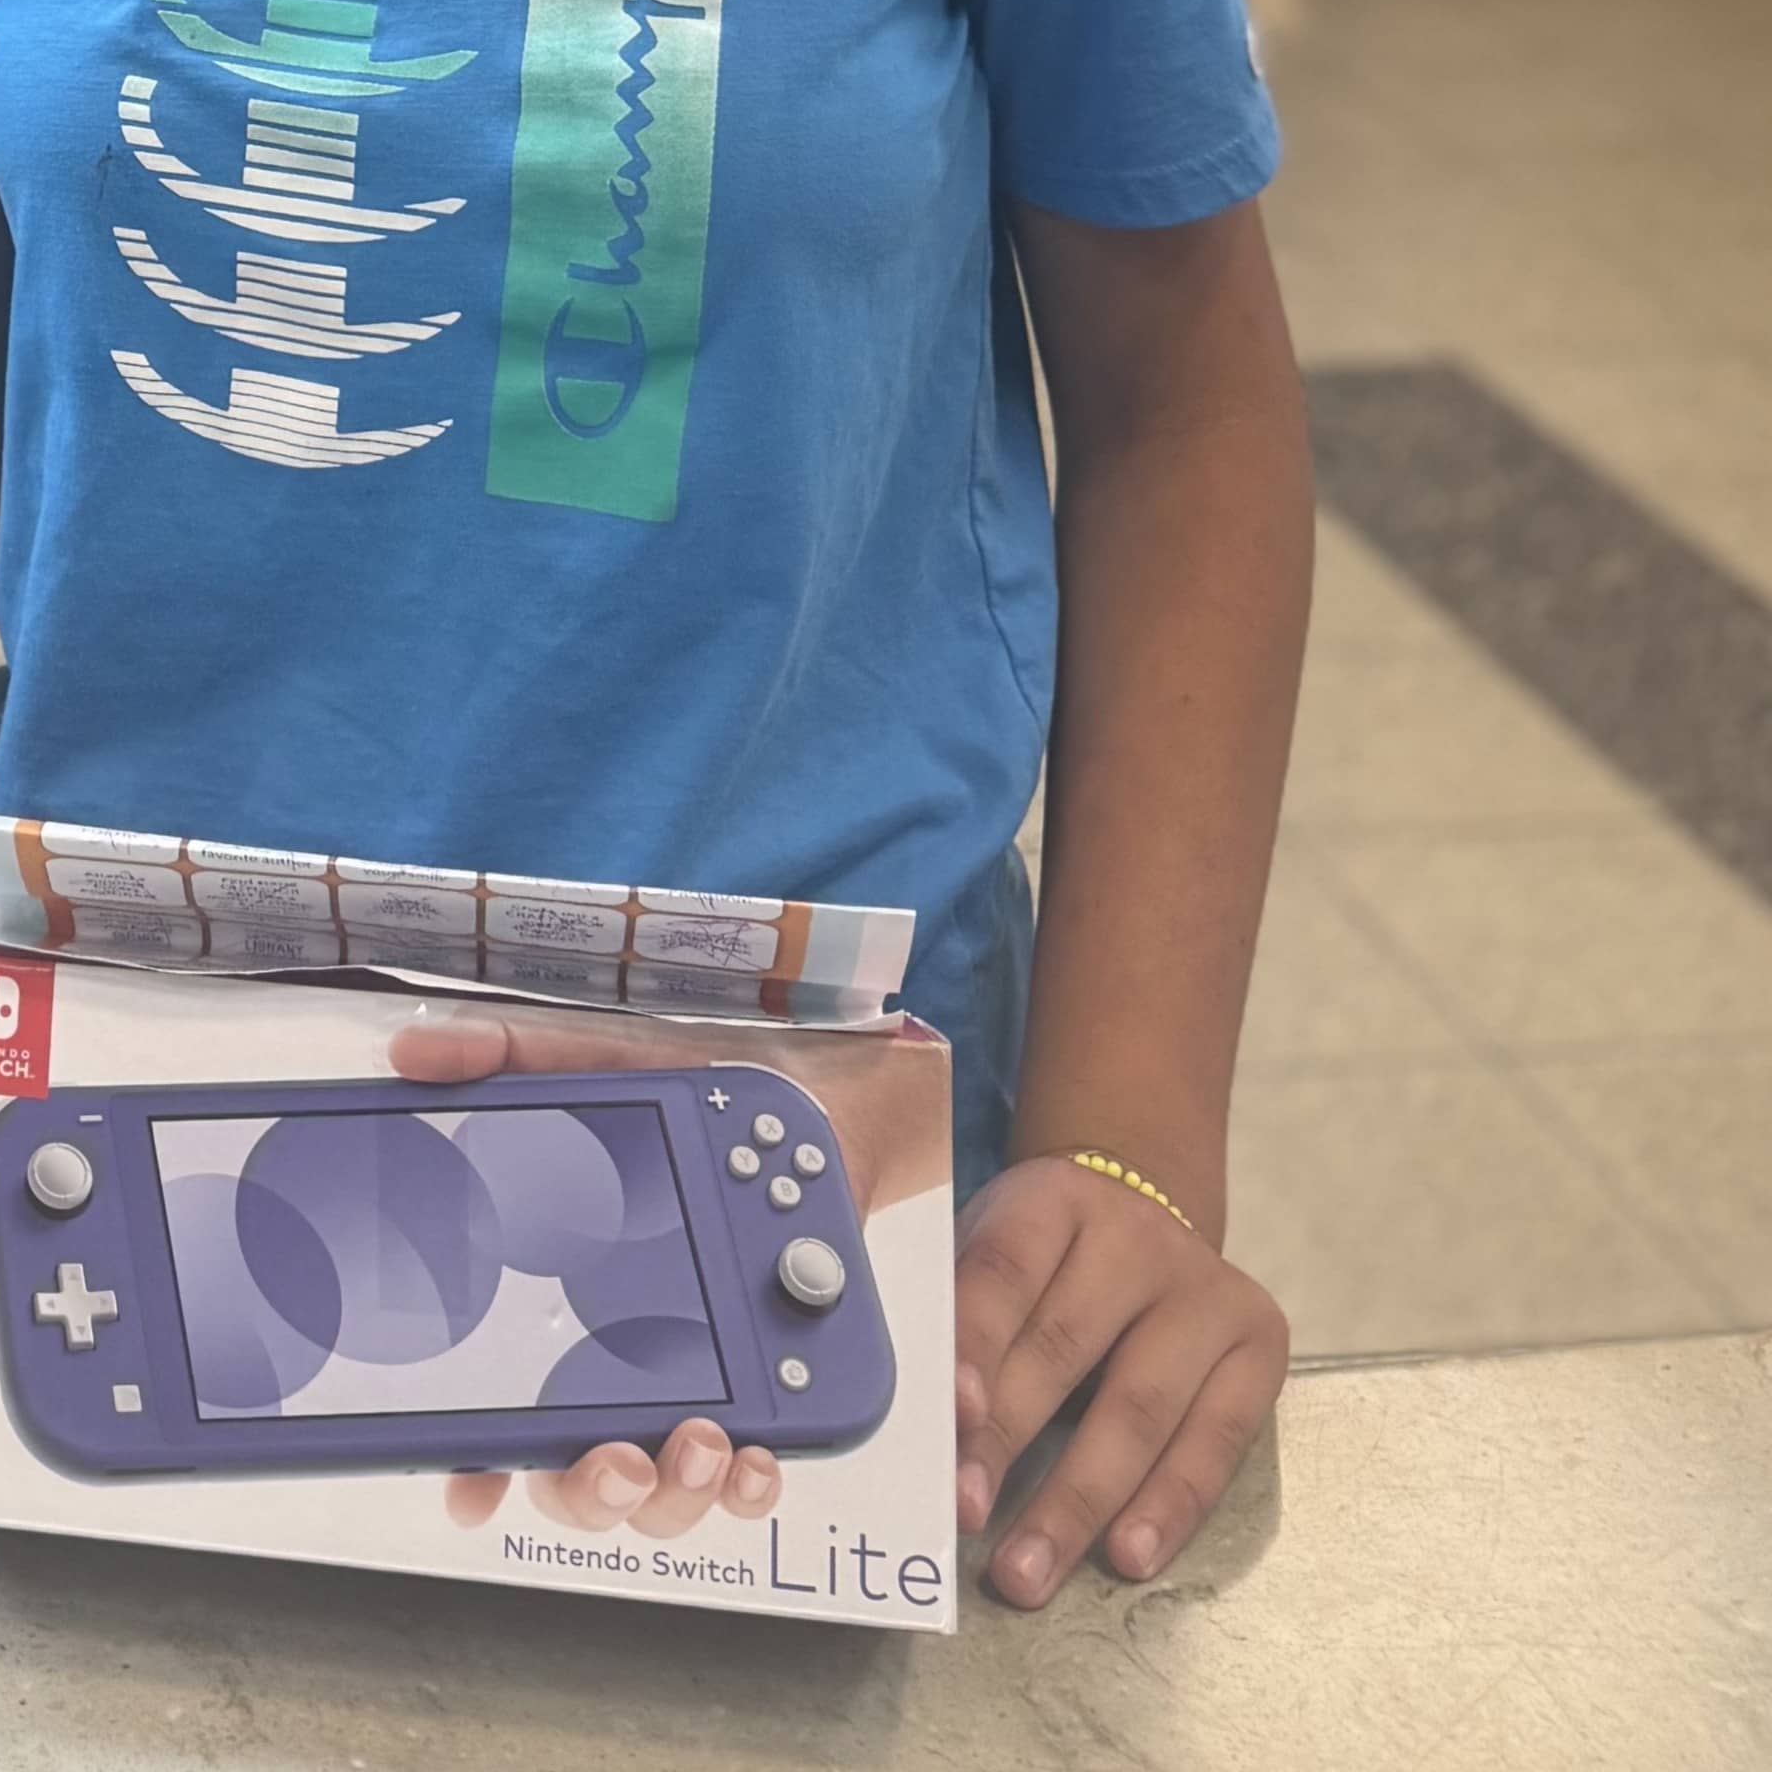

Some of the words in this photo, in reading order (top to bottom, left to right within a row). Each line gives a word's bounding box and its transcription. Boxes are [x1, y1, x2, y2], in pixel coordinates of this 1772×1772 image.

[763, 1119, 778, 1135] X
[737, 1151, 751, 1168] Y
[803, 1150, 817, 1165] A
[780, 1181, 792, 1198] B
[503, 1533, 640, 1573] Nintendo
[652, 1551, 755, 1586] Switch
[770, 1517, 942, 1606] Lite
